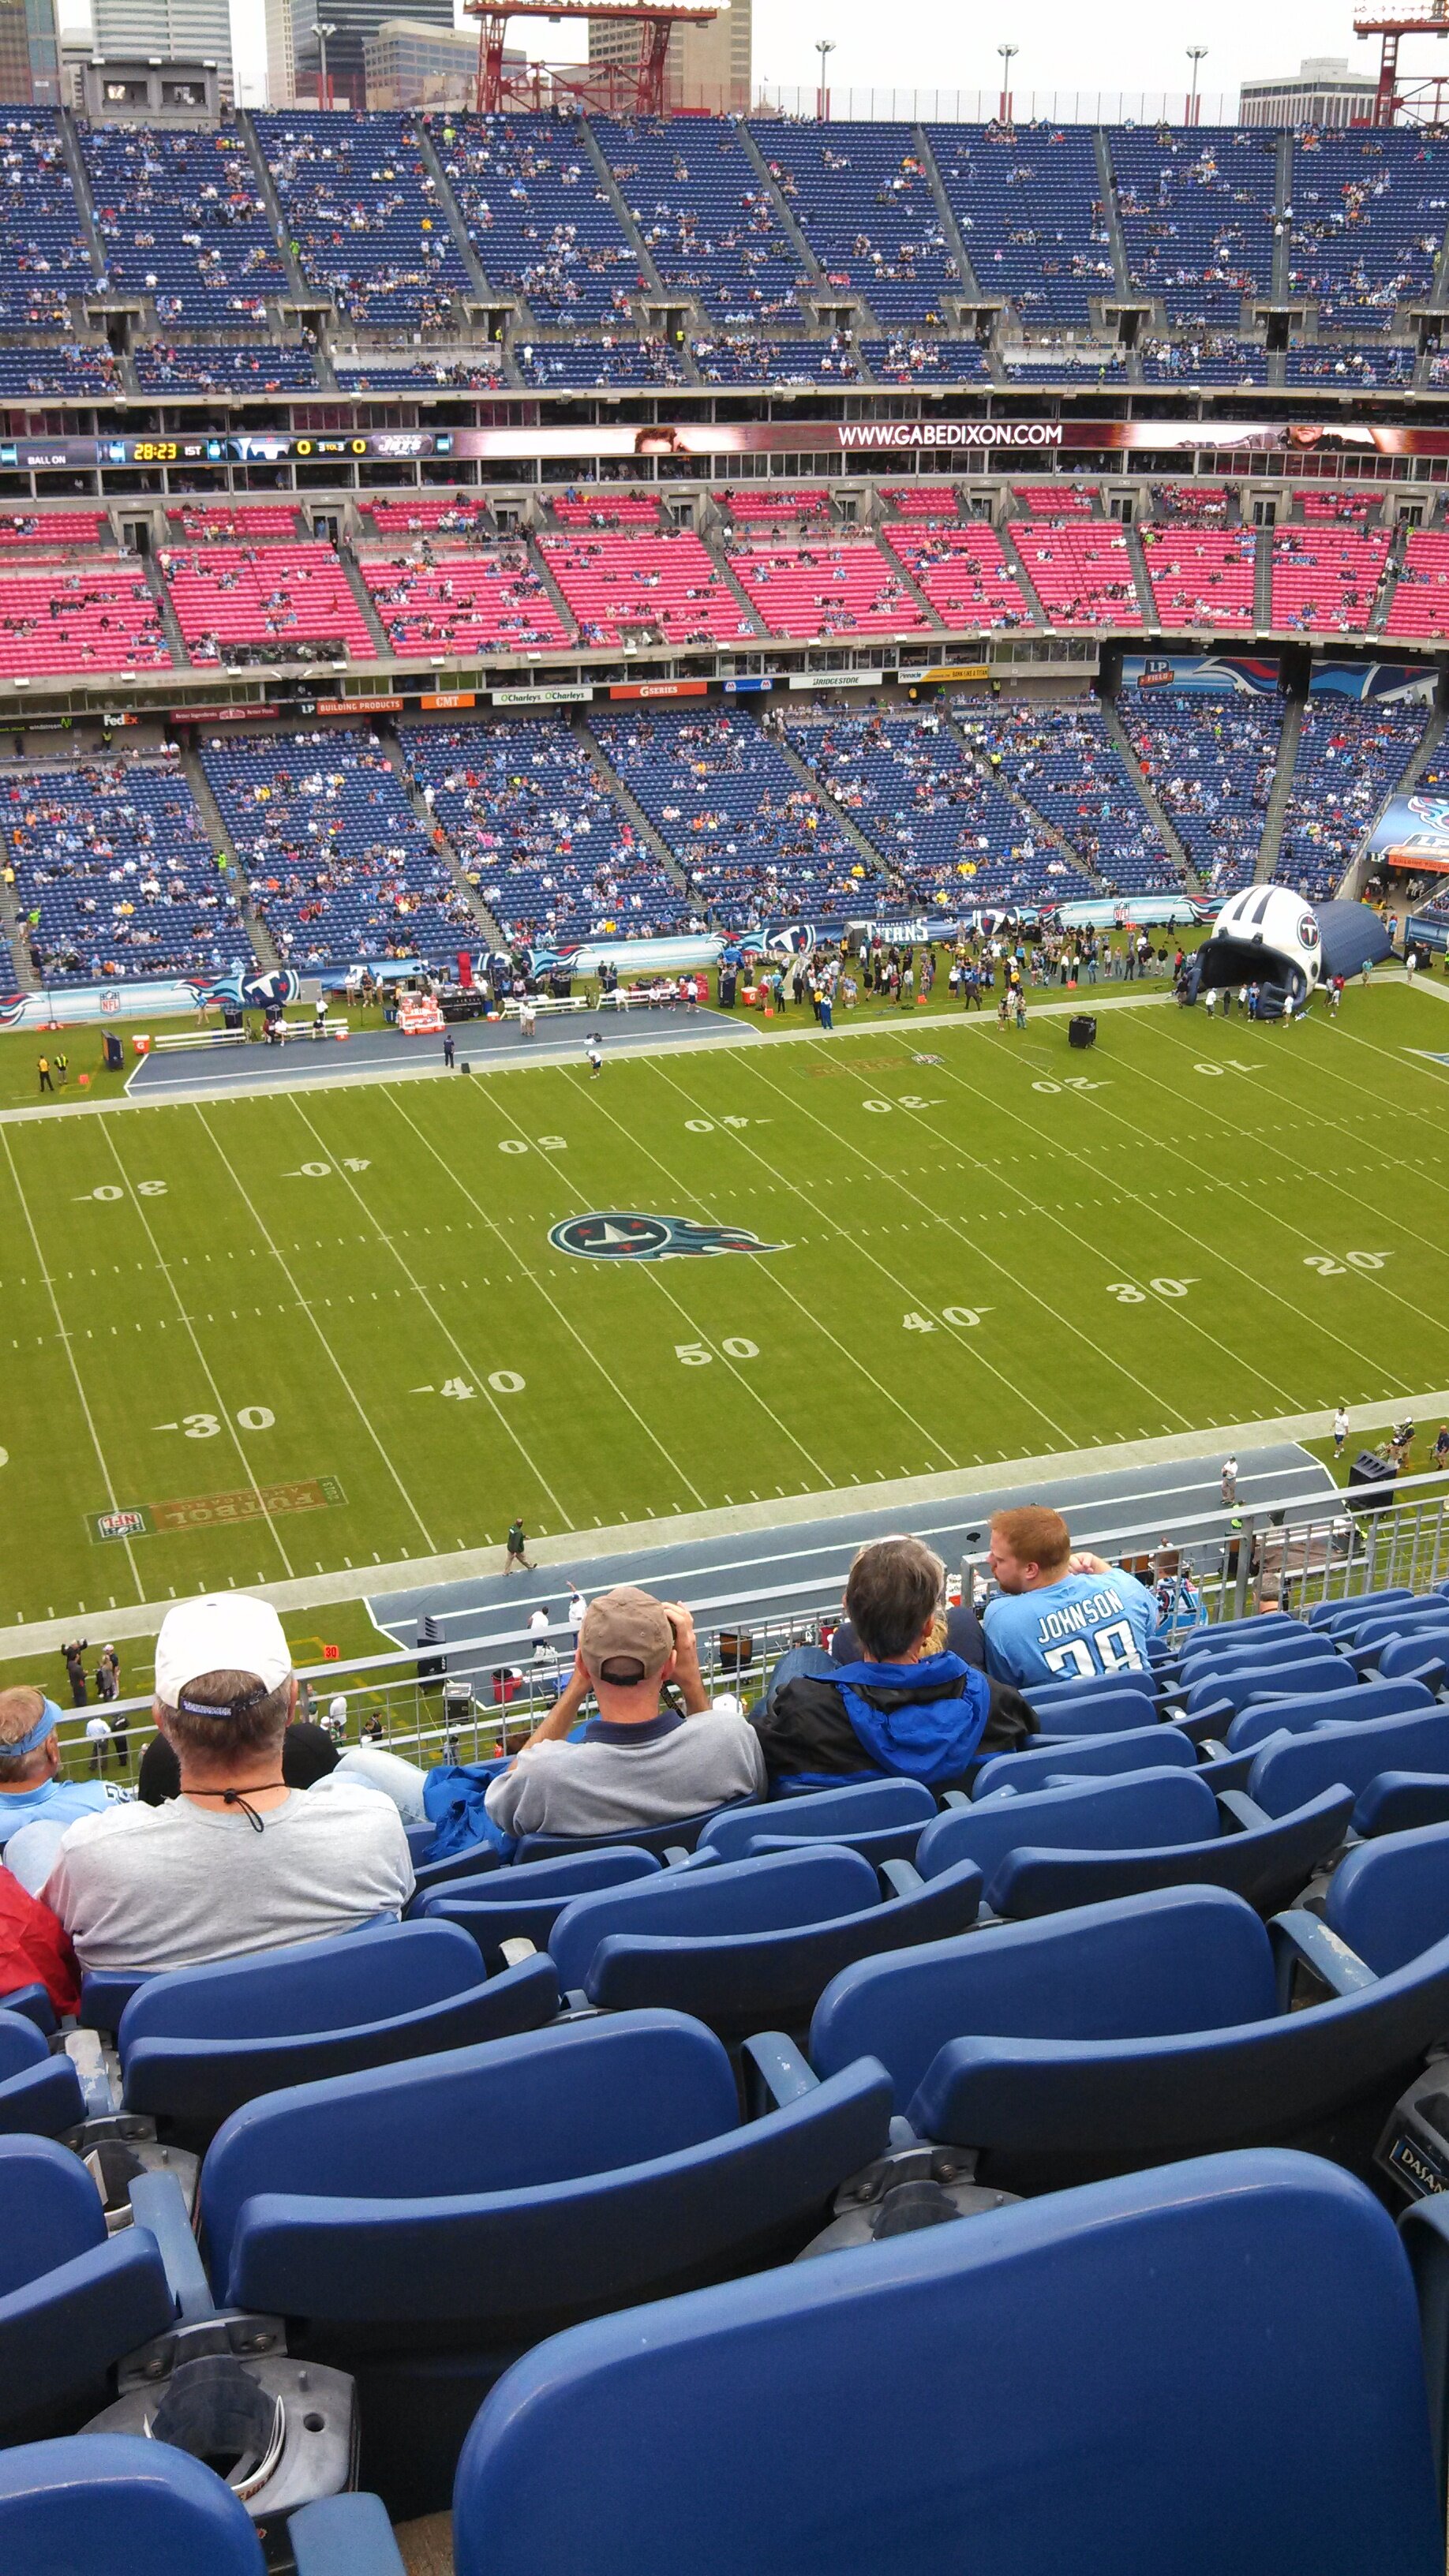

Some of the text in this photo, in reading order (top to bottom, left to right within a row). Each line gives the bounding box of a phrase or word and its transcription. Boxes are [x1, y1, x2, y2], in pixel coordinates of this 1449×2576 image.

[838, 425, 1062, 445] WWW.GABEDIXON.COM
[134, 443, 177, 460] 28:23
[297, 440, 311, 455] 0
[318, 442, 325, 451] 3
[338, 441, 344, 451] 3
[352, 440, 366, 454] 0
[28, 455, 66, 465] BALL ON
[1150, 661, 1166, 672] LP
[1148, 673, 1168, 682] FIELD
[320, 700, 400, 712] BUILDING PRODUCTS
[436, 696, 459, 707] CMT
[301, 705, 315, 714] LP
[103, 713, 138, 726] FedEx
[1371, 852, 1385, 863] LP
[103, 1000, 118, 1010] NFL
[165, 1492, 314, 1524] FUTBOL
[104, 1515, 136, 1529] NFL
[1037, 1588, 1125, 1645] JOHNSON
[325, 1646, 337, 1658] 30
